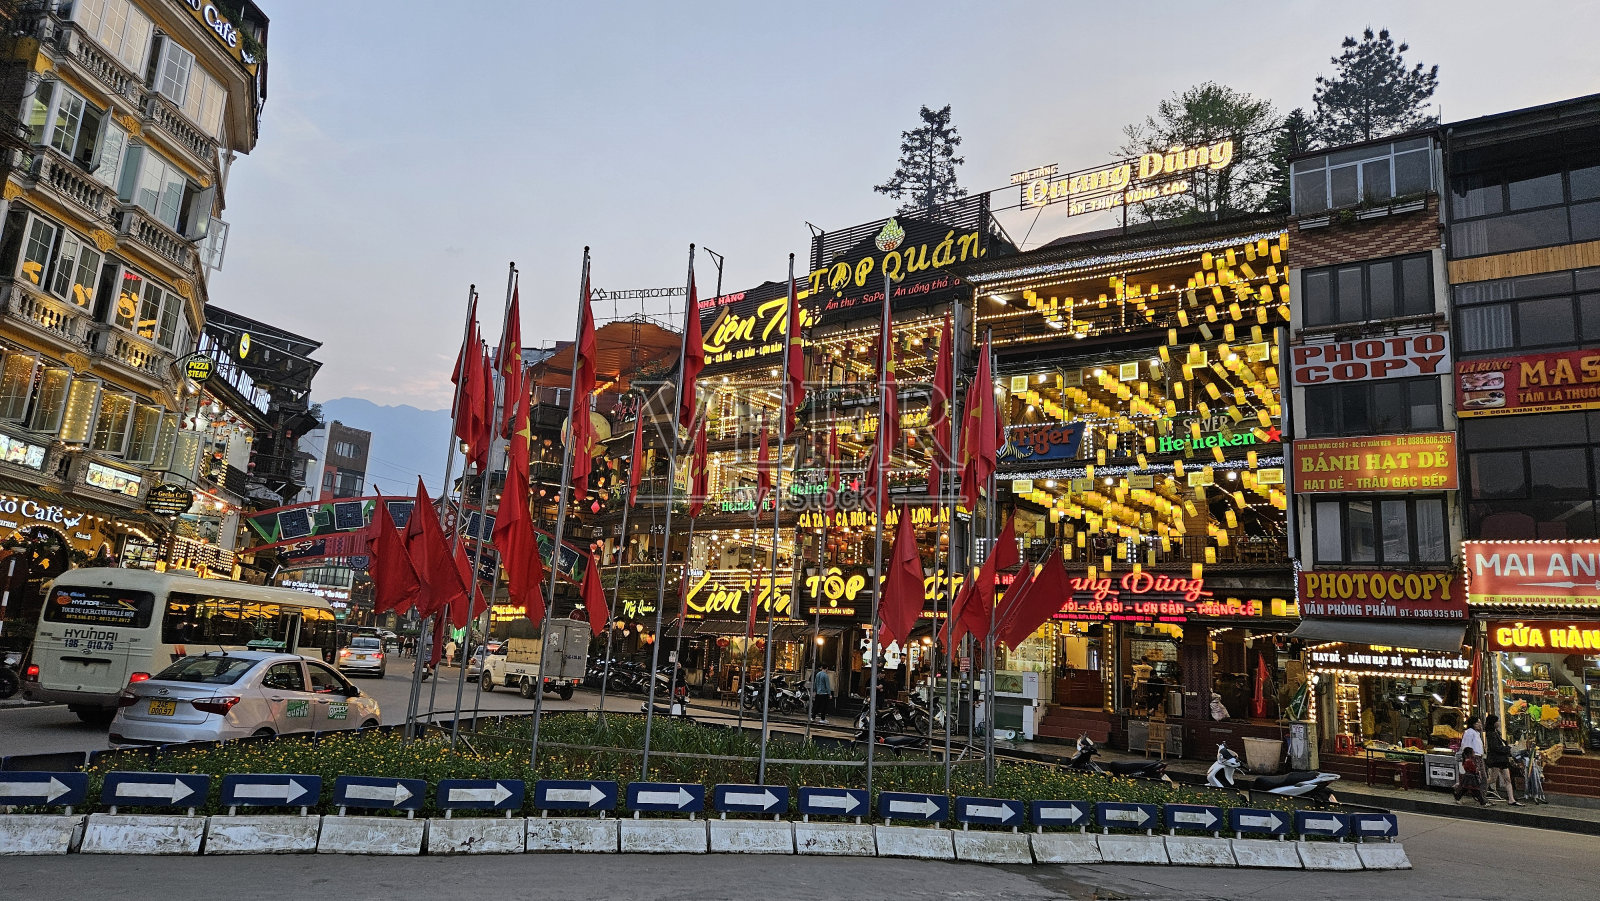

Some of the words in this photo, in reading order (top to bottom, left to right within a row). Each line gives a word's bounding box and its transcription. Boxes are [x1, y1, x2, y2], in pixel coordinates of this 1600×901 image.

[204, 5, 236, 48] Café
[1026, 163, 1130, 206] Quang
[1139, 140, 1233, 180] Dũng
[1031, 166, 1057, 179] HÀNG
[1163, 180, 1188, 196] CAO
[718, 292, 746, 304] HÀNG
[863, 294, 885, 304] SaPa
[1294, 334, 1446, 365] PHOTO
[188, 370, 208, 379] STEAK
[189, 362, 209, 370] PIZZA
[1296, 355, 1446, 384] COPY
[1014, 427, 1074, 453] Tiger
[1302, 452, 1360, 472] BÁNH
[1366, 452, 1412, 474] HẠT
[1418, 444, 1448, 468] DẺ
[1304, 480, 1325, 492] HẠT
[1330, 476, 1344, 488] DẺ
[1356, 475, 1388, 488] TRÂU
[1392, 474, 1418, 488] GÁC
[1422, 472, 1448, 486] BẾP
[21, 500, 63, 523] Café
[800, 510, 811, 527] CÁ
[836, 508, 848, 527] CÁ
[851, 504, 866, 526] HỒI
[912, 506, 931, 523] LỢN
[1475, 553, 1535, 576] MAI
[1546, 553, 1600, 576] AN
[806, 567, 865, 608] TỘP
[1122, 572, 1213, 602] Dũng
[1304, 573, 1452, 600] PHOTOCOPY
[623, 600, 636, 619] Mỹ
[638, 600, 656, 616] Quán
[1088, 598, 1102, 612] GÀ
[1134, 602, 1158, 614] LỢN
[1304, 600, 1324, 615] VĂN
[1327, 601, 1362, 616] PHÒNG
[1365, 599, 1396, 616] PHẨM
[1414, 610, 1433, 618] 0368
[1434, 610, 1448, 618] 935
[64, 629, 118, 641] HYUNDAI
[1497, 622, 1544, 647] CỬA
[1312, 652, 1329, 665] HẠT
[1330, 650, 1340, 662] DẺ
[1348, 652, 1372, 664] BÁNH
[1372, 655, 1388, 668] HẠT
[1391, 654, 1403, 666] DẺ
[1411, 656, 1434, 668] TRÂU
[1436, 656, 1452, 668] GÁC
[1452, 655, 1469, 670] BẾP
[1506, 678, 1549, 690] Massage
